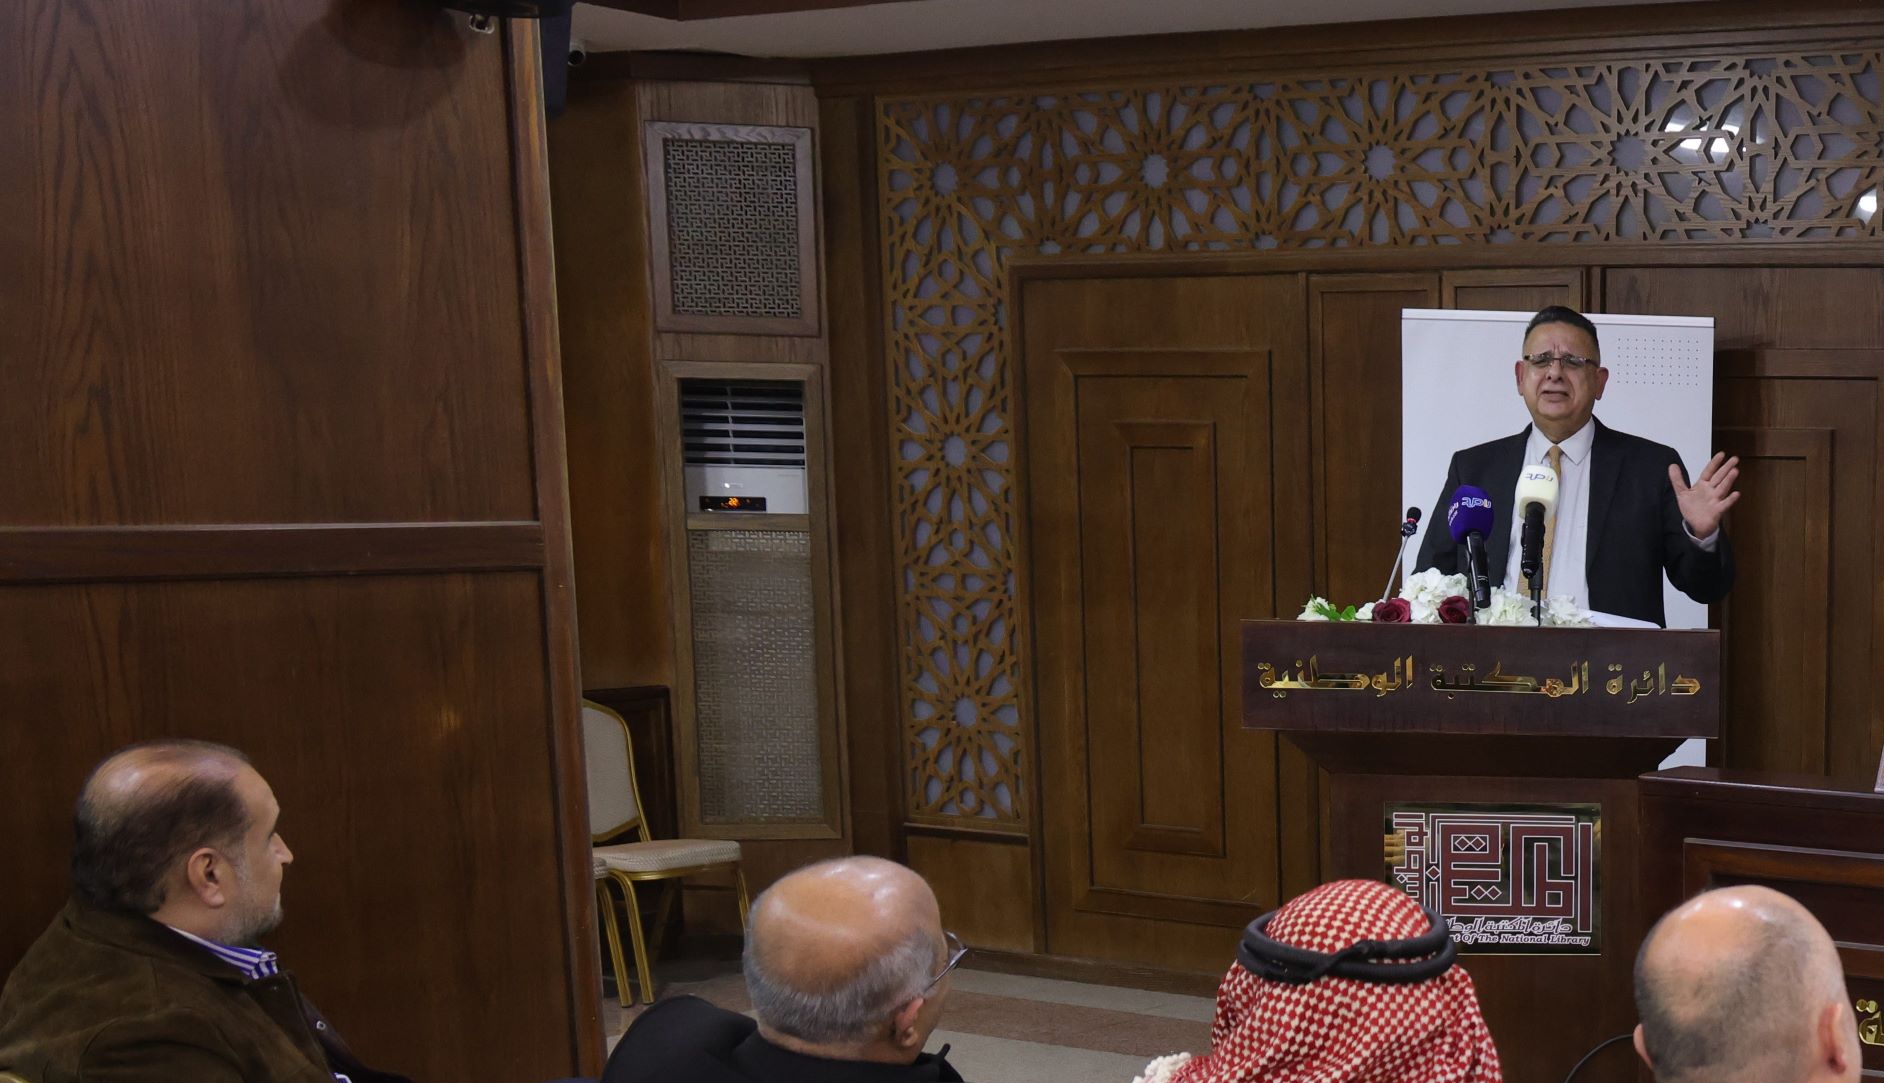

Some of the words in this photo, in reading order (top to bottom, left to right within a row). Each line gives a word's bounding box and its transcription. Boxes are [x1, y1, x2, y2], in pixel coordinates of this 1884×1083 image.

[1257, 654, 1413, 699] الوطنية
[1430, 661, 1589, 699] المكتبة
[1606, 662, 1701, 704] دائرة
[1462, 933, 1475, 944] Of
[1478, 933, 1499, 944] The
[1500, 933, 1549, 945] National
[1549, 935, 1591, 946] Library
